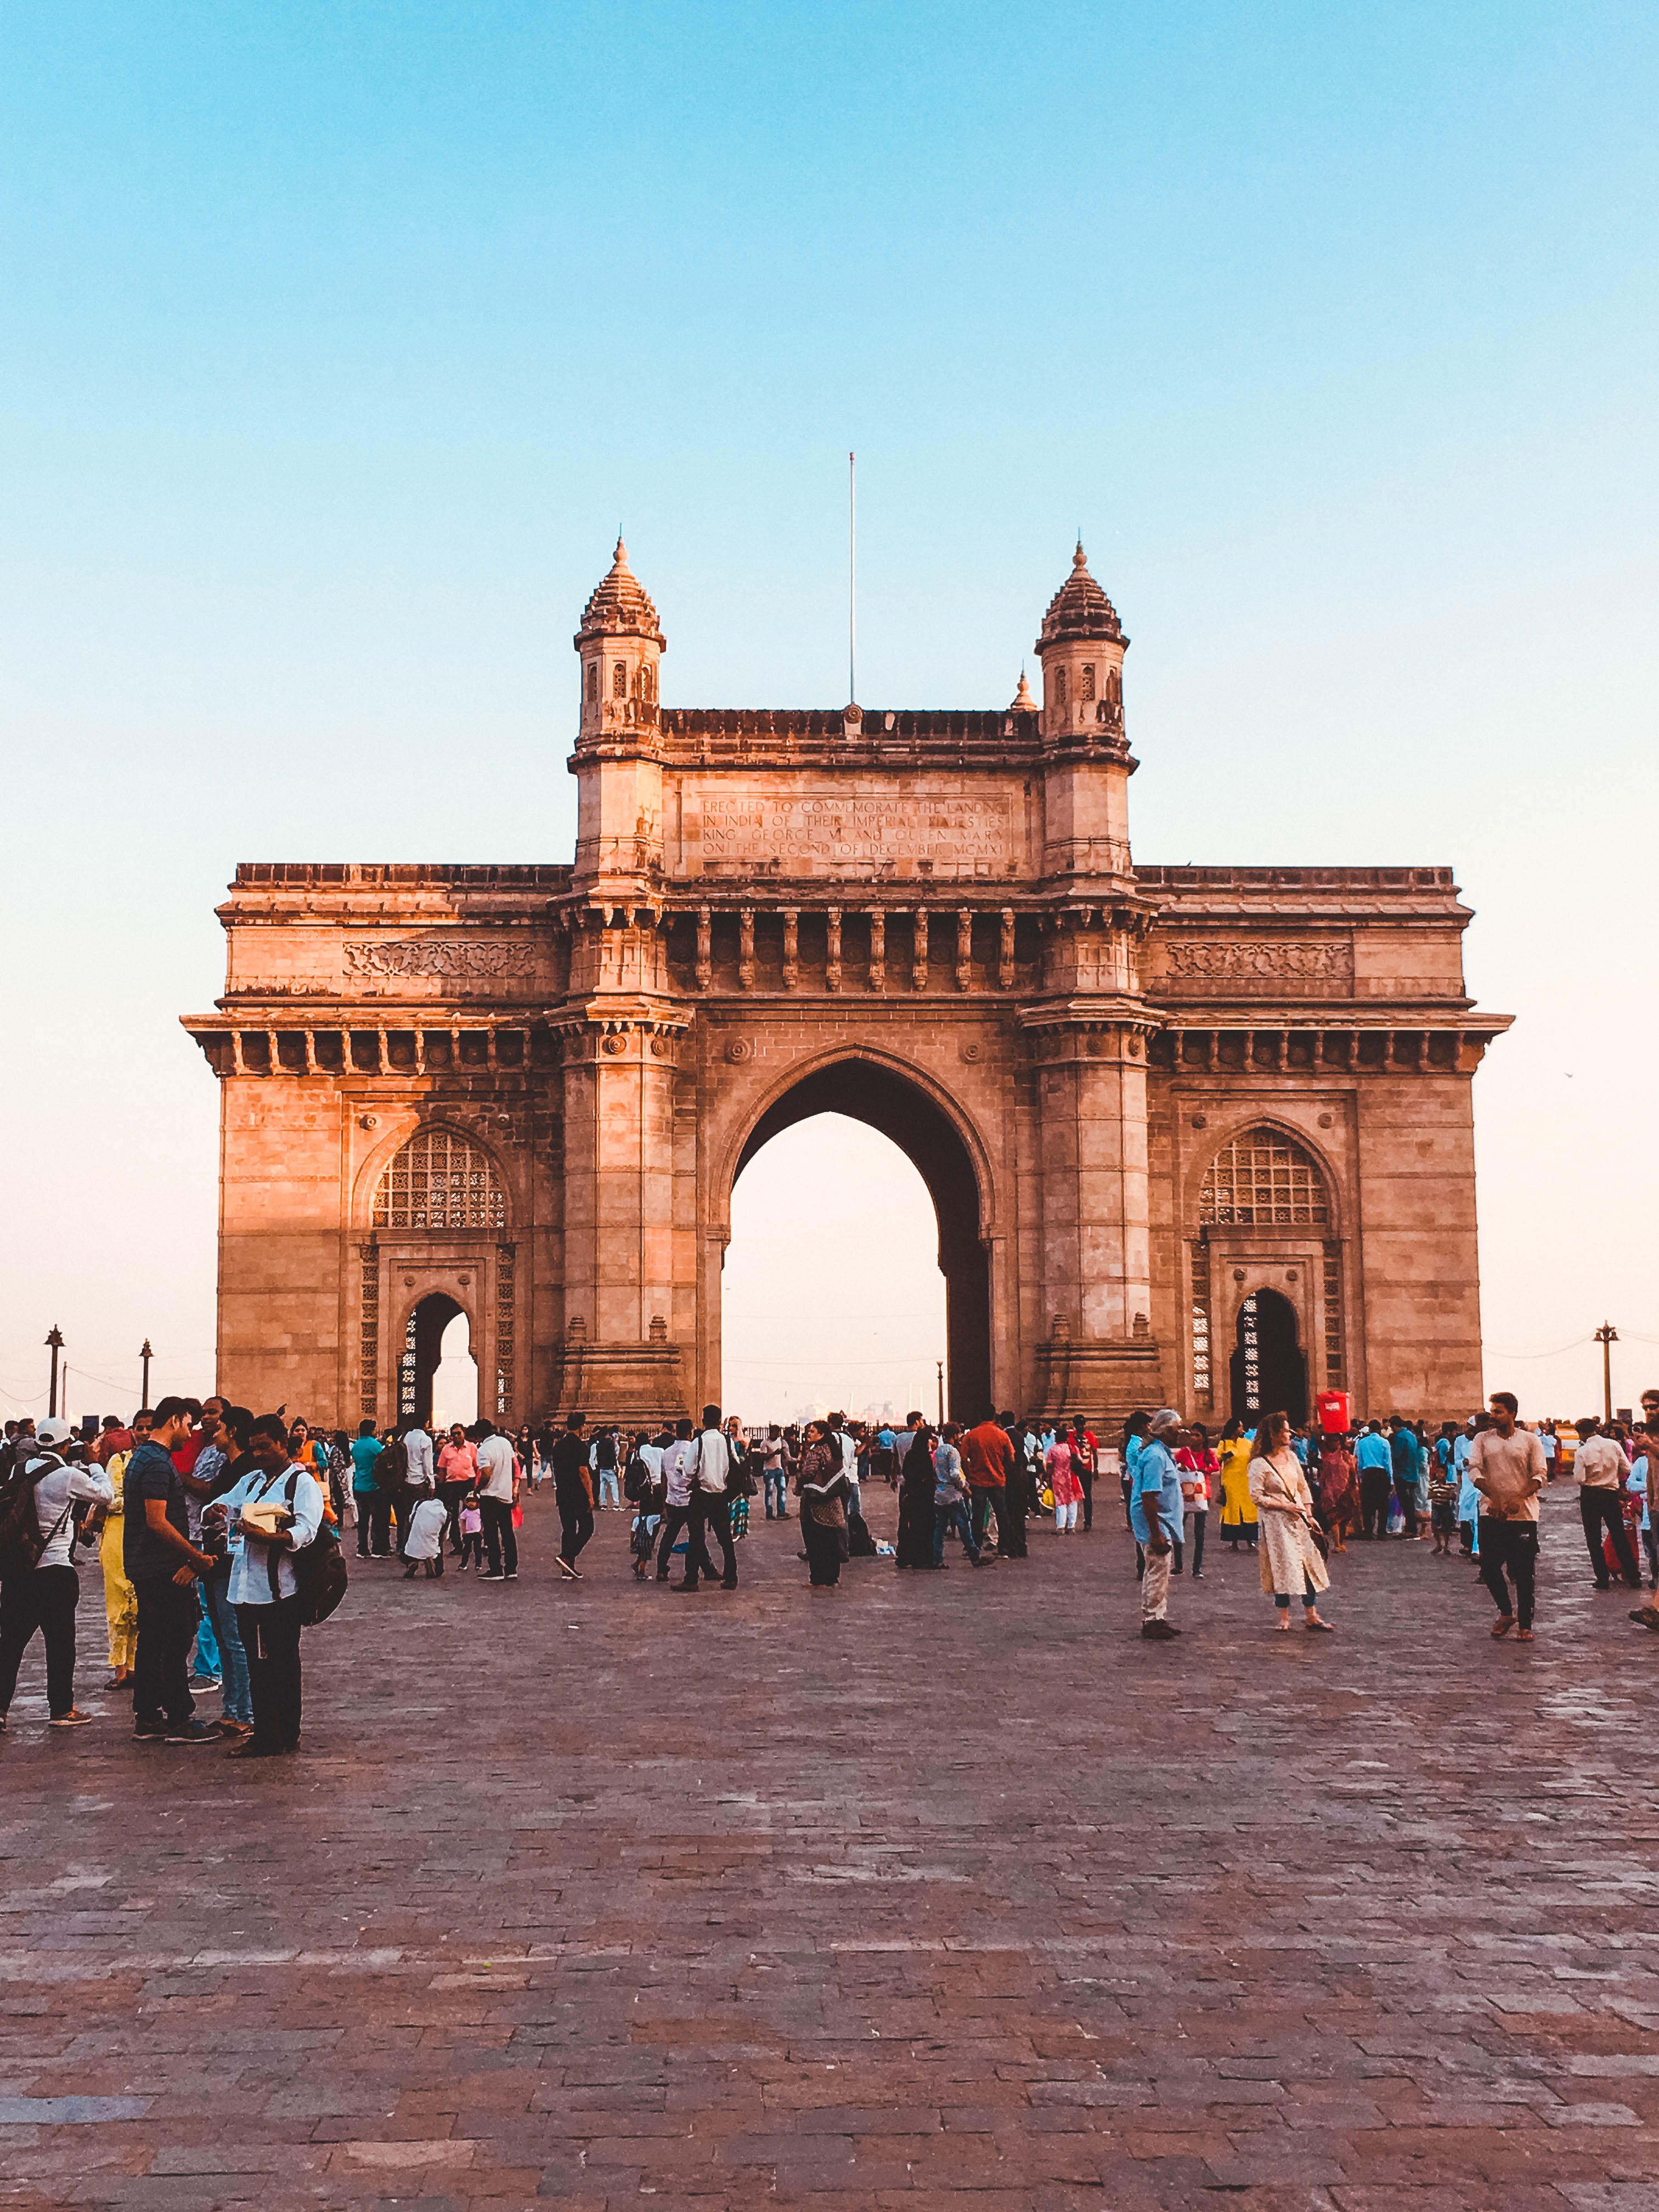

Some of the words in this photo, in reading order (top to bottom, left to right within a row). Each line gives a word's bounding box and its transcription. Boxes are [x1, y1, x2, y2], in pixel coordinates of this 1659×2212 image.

[703, 800, 764, 812] ERECTED
[772, 801, 792, 812] TO
[801, 801, 909, 813] COMMEMORATE
[917, 802, 940, 814] THE
[703, 815, 716, 827] IN
[725, 815, 762, 827] INDIA
[772, 815, 790, 826] OF
[807, 815, 842, 827] THEIR
[854, 815, 916, 828] IMPERIAL
[703, 829, 736, 840] KING
[752, 829, 814, 840] GEORGE
[855, 830, 882, 841] AND
[895, 830, 946, 841] QUEEN
[961, 830, 1002, 840] MARY
[703, 843, 725, 854] ON
[736, 843, 759, 854] THE
[770, 843, 830, 854] SECOND
[840, 843, 860, 855] OF
[870, 843, 942, 855] DECEMBER
[954, 844, 1002, 855] MCMXI
